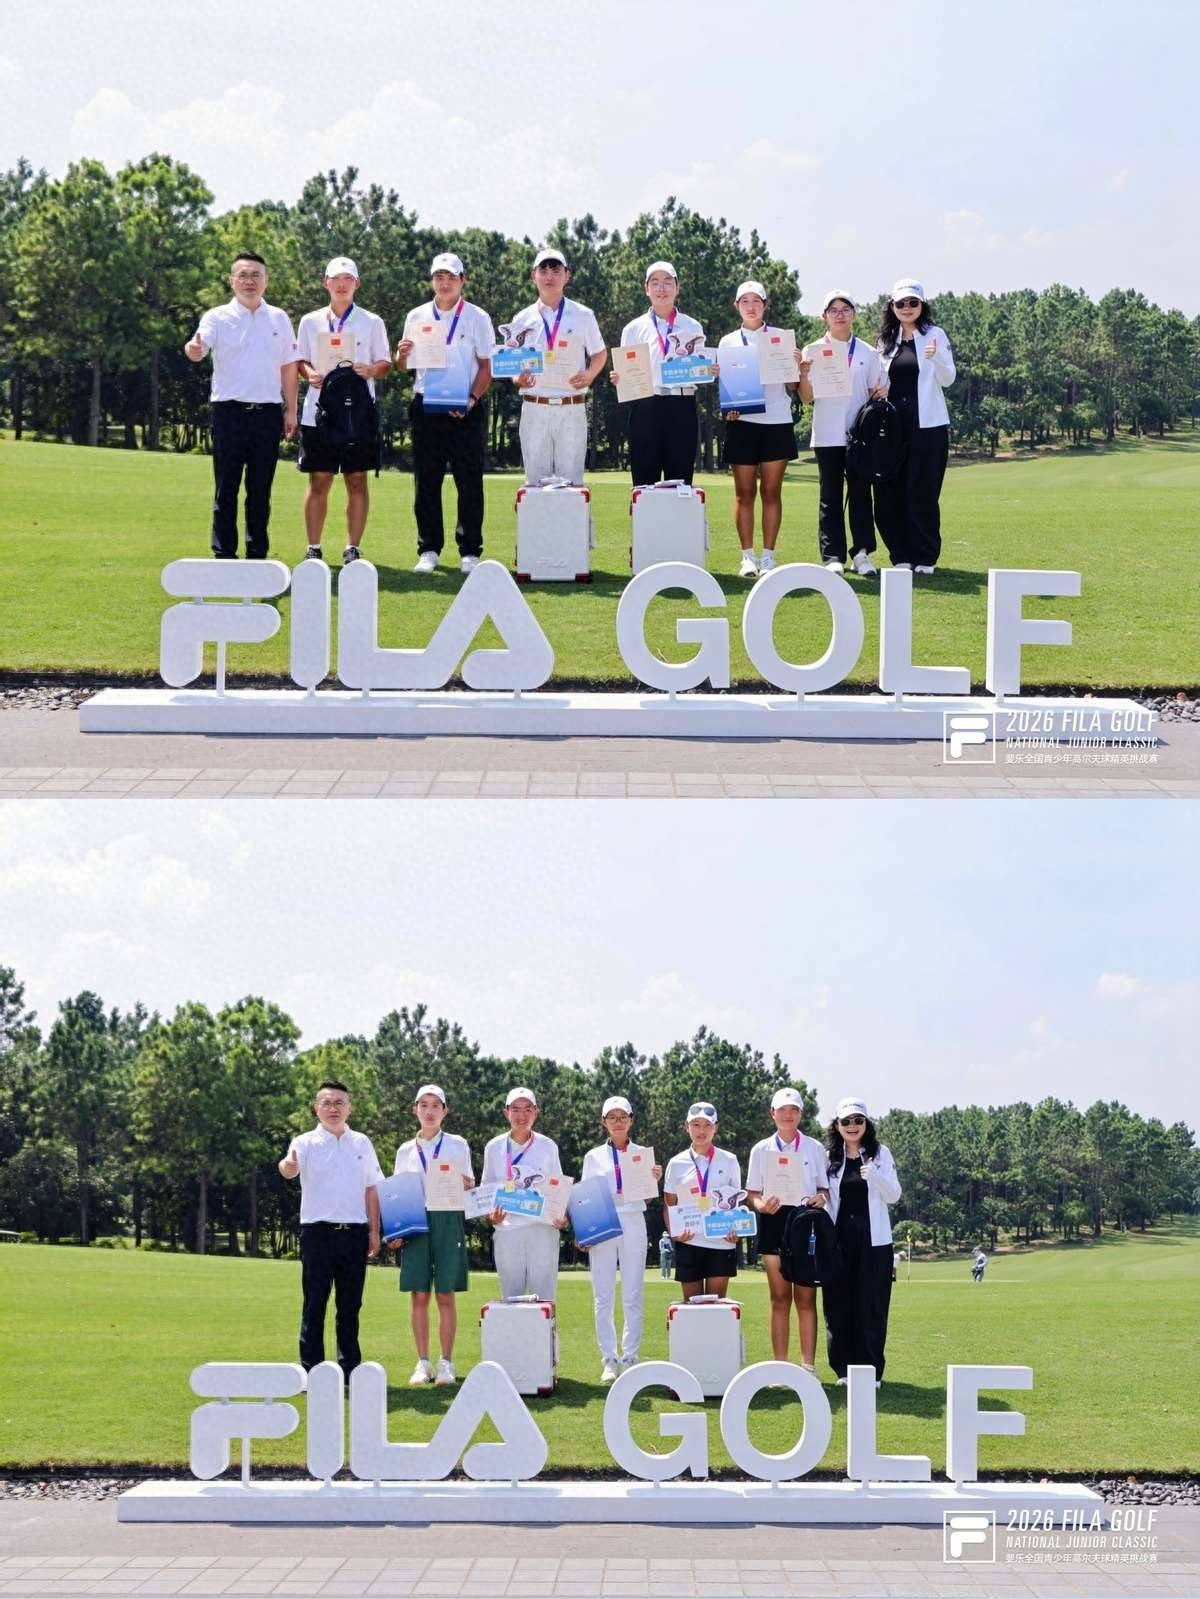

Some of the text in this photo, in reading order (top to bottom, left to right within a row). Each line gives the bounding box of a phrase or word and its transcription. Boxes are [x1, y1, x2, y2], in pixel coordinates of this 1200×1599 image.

[161, 558, 1082, 694] FILA GOLF
[189, 1360, 1033, 1482] FILA GOLF
